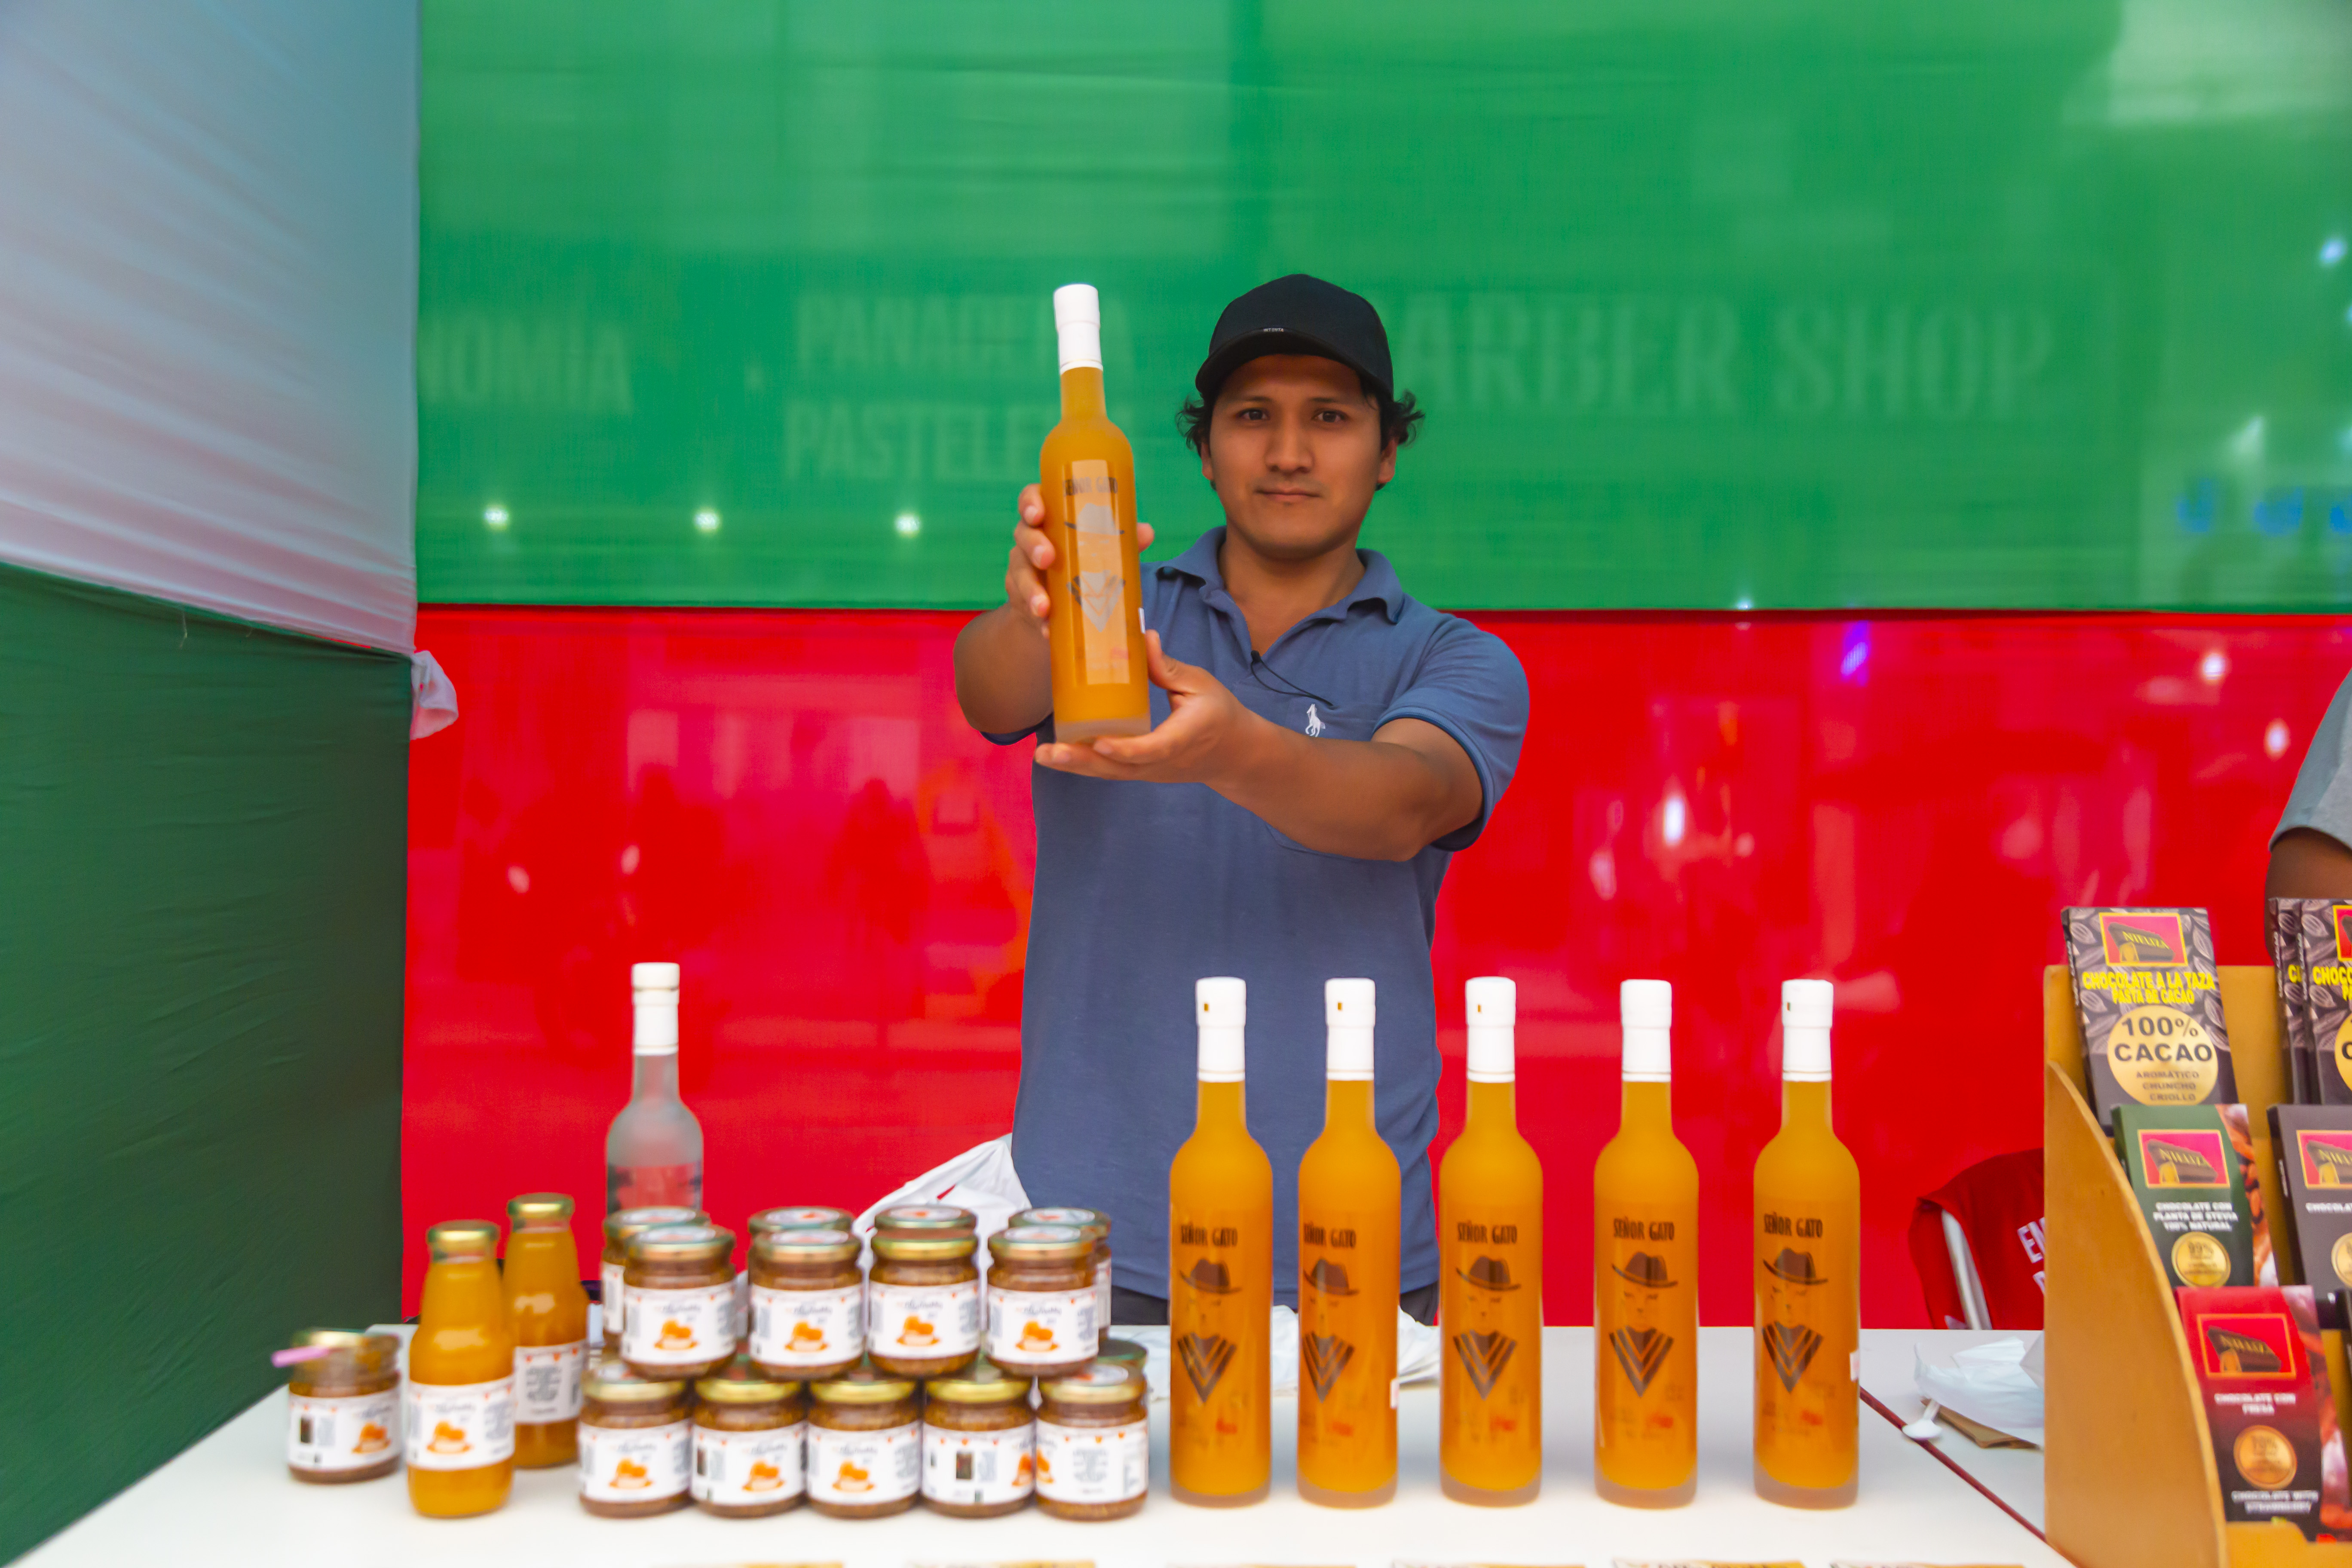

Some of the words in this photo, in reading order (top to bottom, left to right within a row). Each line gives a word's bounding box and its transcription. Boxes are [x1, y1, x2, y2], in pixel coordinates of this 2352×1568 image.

[1395, 292, 1737, 413] ARBER
[1773, 300, 2050, 420] SHOP
[2082, 971, 2153, 989] CHOCOLATE
[2156, 971, 2165, 989] A
[2166, 972, 2183, 989] LA
[2184, 972, 2215, 989] TAZA
[2112, 988, 2144, 1004] PASTA
[2145, 989, 2159, 1003] DE
[2160, 989, 2195, 1004] CACAO
[2122, 1016, 2199, 1037] 100%
[2114, 1043, 2212, 1062] CACAO
[1212, 1227, 1238, 1247] GATO
[1492, 1225, 1518, 1244] GATO
[1649, 1221, 1675, 1241] GATO
[1796, 1218, 1823, 1238] GATO
